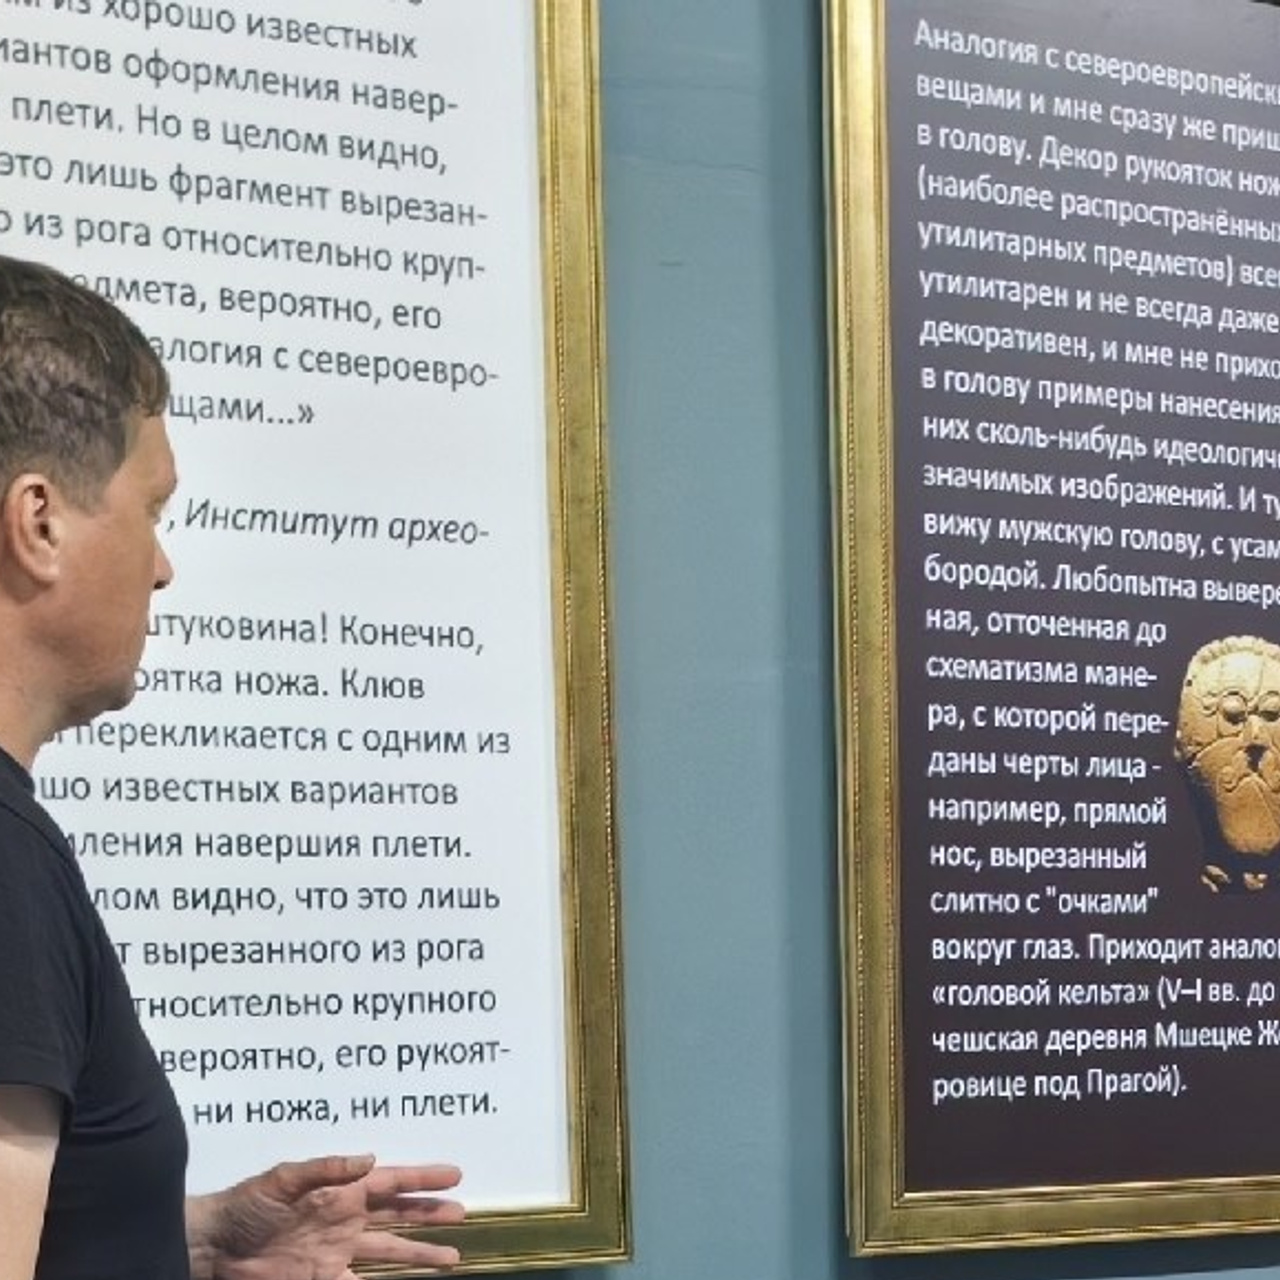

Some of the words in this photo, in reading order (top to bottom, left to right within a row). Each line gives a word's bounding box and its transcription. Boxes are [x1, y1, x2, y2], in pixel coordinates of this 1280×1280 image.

[102, 0, 238, 36] хорошо
[246, 12, 418, 59] известных
[914, 19, 1038, 65] Аналогия
[1045, 47, 1059, 69] с
[122, 47, 340, 103] оформления
[351, 82, 458, 123] навер-
[12, 96, 123, 133] плети.
[137, 103, 182, 139] Но
[192, 117, 211, 142] в
[221, 121, 328, 157] целом
[338, 134, 447, 176] видно,
[917, 123, 933, 146] в
[939, 127, 1032, 166] голову.
[1038, 135, 1118, 178] Декор
[1125, 154, 1233, 190] рукояток
[63, 159, 158, 192] лишь
[168, 162, 332, 211] фрагмент
[341, 189, 488, 227] вырезан-
[917, 163, 1054, 212] (наиболее
[23, 211, 64, 240] из
[74, 217, 151, 248] рога
[161, 225, 392, 272] относительно
[403, 250, 485, 286] круп-
[917, 221, 1087, 263] утилитарных
[1093, 244, 1234, 288] предметов)
[219, 286, 382, 331] вероятно,
[392, 303, 442, 330] его
[272, 346, 290, 371] с
[297, 348, 498, 393] североевро-
[923, 415, 970, 441] них
[975, 421, 1148, 462] сколь-нибудь
[923, 464, 1054, 496] значимых
[1060, 472, 1234, 511] изображений.
[1238, 484, 1257, 513] И
[184, 497, 379, 545] Институт
[388, 517, 489, 549] архео-
[923, 552, 1047, 592] бородой.
[1051, 563, 1198, 600] Любопытна
[339, 614, 484, 656] Конечно,
[235, 670, 329, 697] ножа.
[341, 667, 426, 700] Клюв
[925, 655, 1079, 684] схематизма
[1084, 664, 1158, 688] мане-
[337, 728, 355, 753] с
[361, 728, 468, 759] одним
[477, 731, 511, 754] из
[926, 750, 997, 778] даны
[1003, 752, 1080, 783] черты
[1084, 756, 1147, 785] лица
[102, 777, 281, 804] известных
[290, 780, 459, 811] вариантов
[928, 798, 1067, 829] например,
[1073, 796, 1167, 829] прямой
[195, 832, 361, 865] навершия
[372, 835, 472, 858] плети.
[930, 844, 983, 873] нос,
[989, 840, 1147, 874] вырезанный
[172, 887, 285, 917] видно,
[295, 886, 349, 911] что
[357, 886, 408, 911] это
[416, 887, 501, 911] лишь
[142, 939, 362, 973] вырезанного
[371, 938, 406, 964] из
[416, 938, 485, 970] рога
[931, 937, 1018, 966] вокруг
[1022, 937, 1081, 960] глаз.
[1088, 932, 1204, 966] Приходит
[352, 989, 497, 1022] крупного
[932, 977, 1052, 1007] «головой
[1058, 983, 1151, 1006] кельта»
[1207, 982, 1241, 1003] вв.
[1246, 980, 1275, 1008] до
[932, 1029, 1039, 1053] чешская
[1043, 1028, 1148, 1057] деревня
[1154, 1020, 1253, 1052] Мшецке
[161, 1046, 325, 1080] вероятно,
[335, 1044, 388, 1069] его
[397, 1040, 511, 1073] рукоят-
[932, 1075, 1028, 1106] ровице
[1033, 1074, 1082, 1101] под
[1086, 1063, 1188, 1101] Прагой).
[192, 1102, 234, 1126] ни
[246, 1098, 339, 1126] ножа,
[350, 1095, 390, 1120] ни
[401, 1091, 498, 1117] плети.
